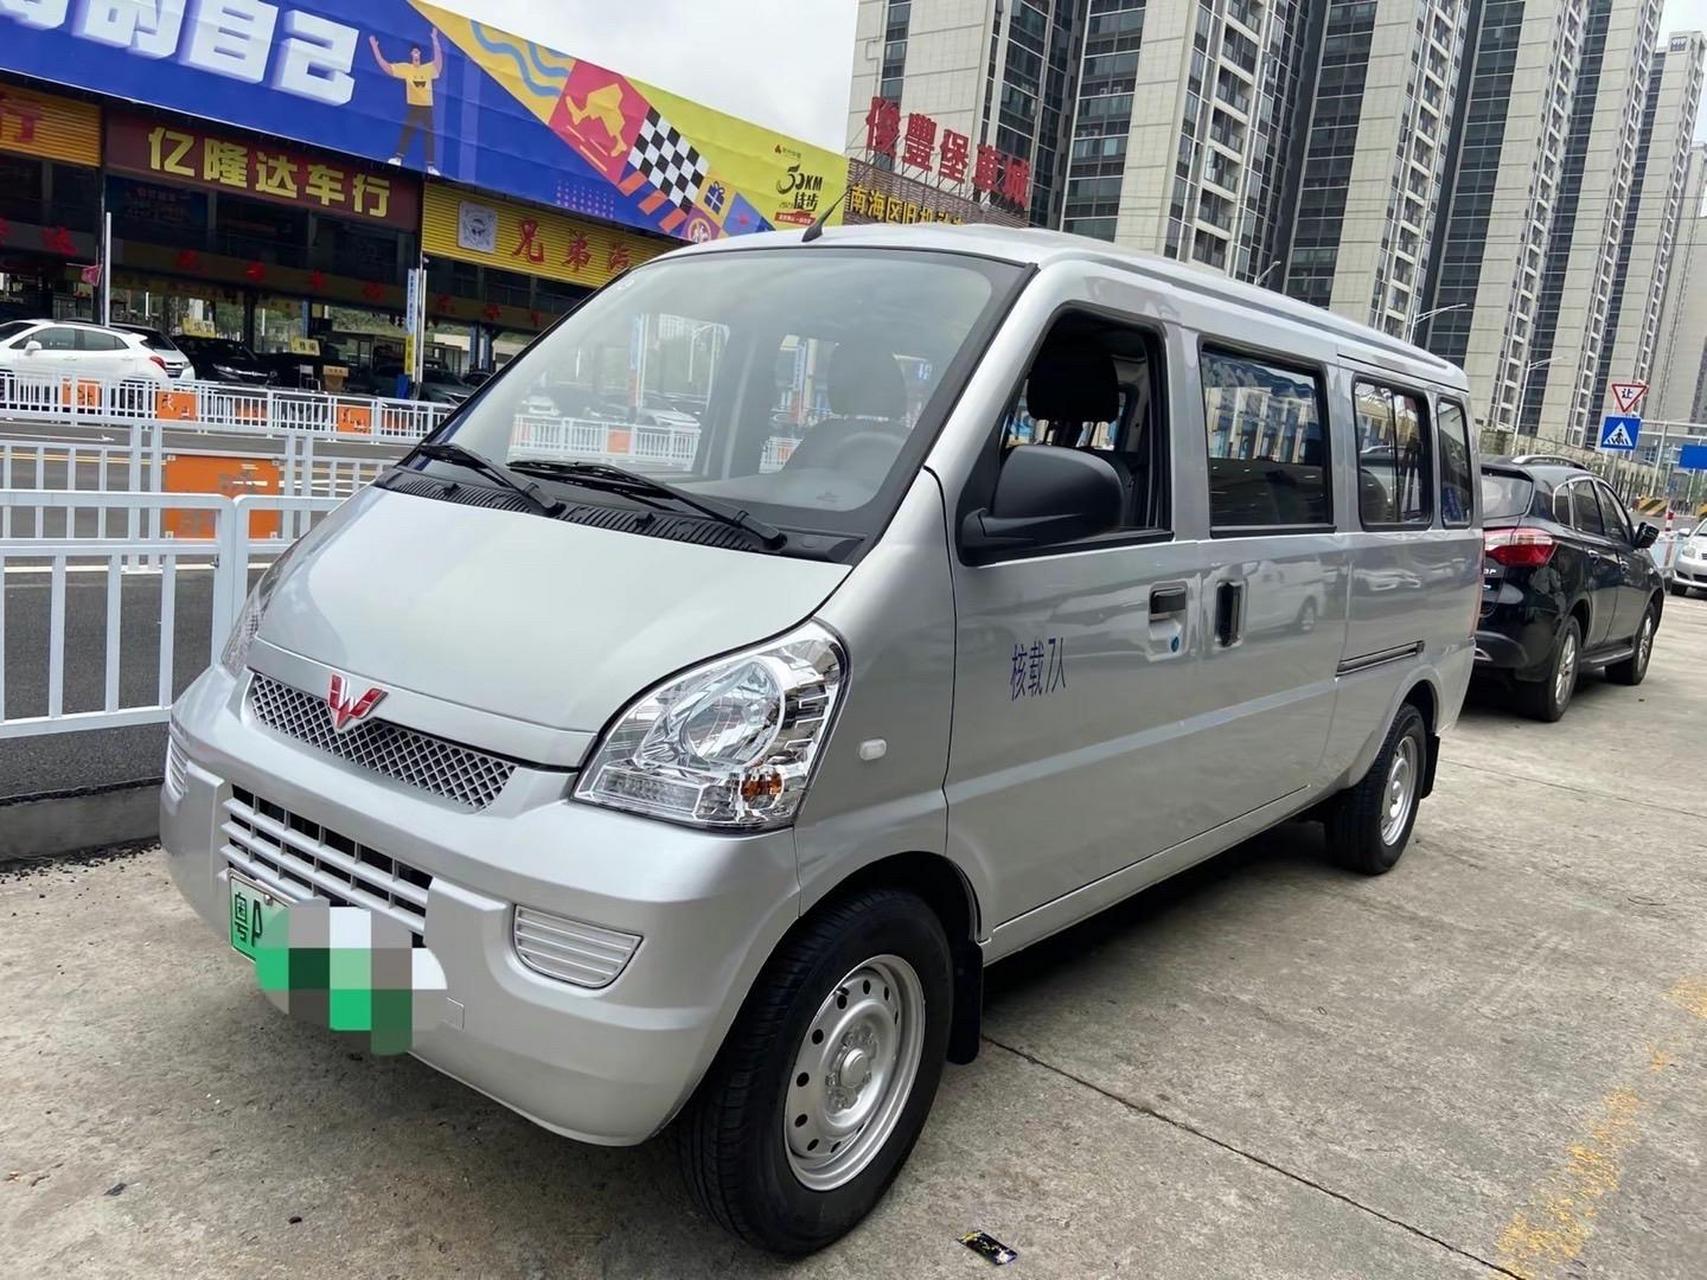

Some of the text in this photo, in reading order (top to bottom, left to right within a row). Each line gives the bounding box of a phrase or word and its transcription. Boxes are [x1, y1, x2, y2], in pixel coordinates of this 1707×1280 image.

[0, 0, 360, 106] 的自己
[148, 127, 390, 218] 亿隆达车行
[1621, 388, 1633, 399] 让
[1010, 636, 1066, 701] 核载7人
